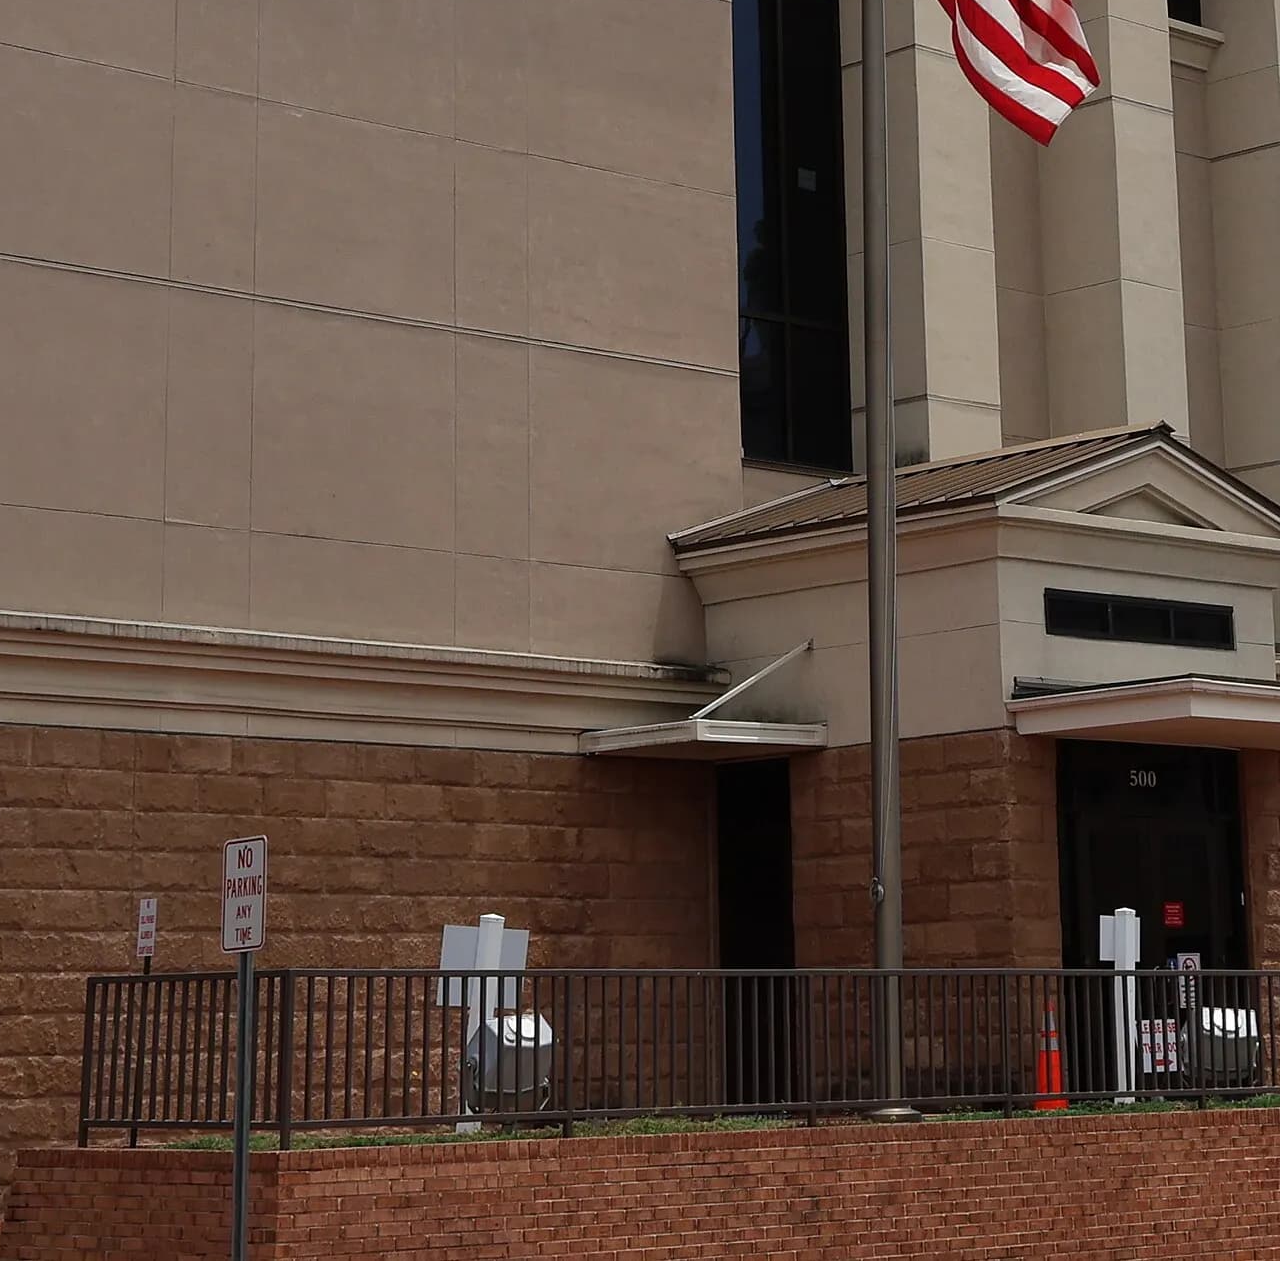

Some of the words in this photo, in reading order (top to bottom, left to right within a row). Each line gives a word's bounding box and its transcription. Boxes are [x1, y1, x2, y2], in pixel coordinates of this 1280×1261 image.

[1129, 769, 1157, 788] 500
[237, 846, 254, 870] NO
[226, 874, 263, 900] PARKING
[235, 903, 252, 921] ANY
[235, 926, 253, 942] TIME
